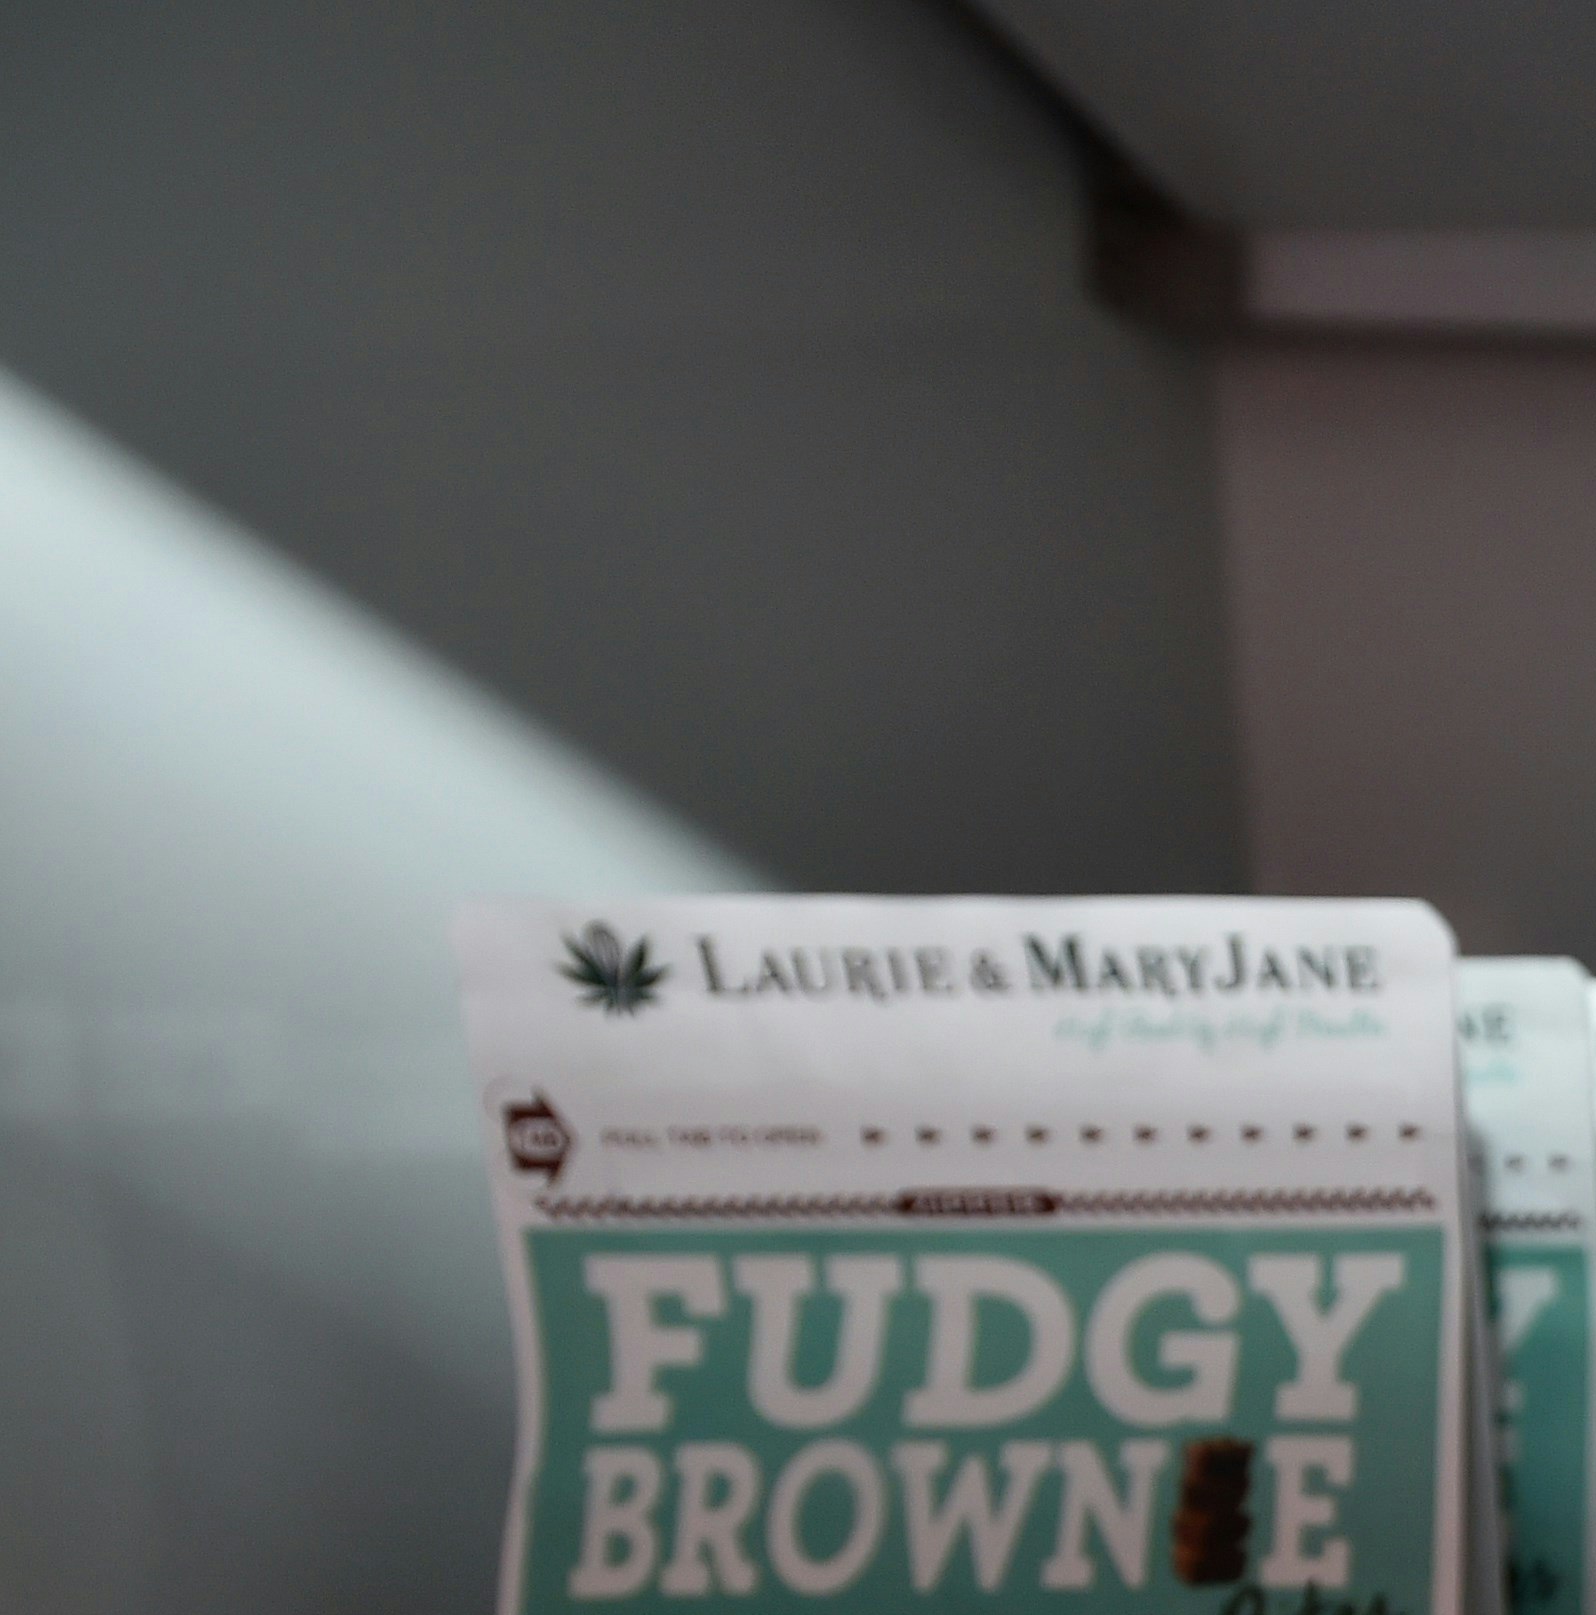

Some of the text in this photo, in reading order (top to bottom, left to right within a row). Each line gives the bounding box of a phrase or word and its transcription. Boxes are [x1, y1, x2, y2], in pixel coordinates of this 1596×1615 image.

[697, 933, 1380, 1002] LAURIE & MARYJANE
[583, 1250, 1407, 1431] FUDGY
